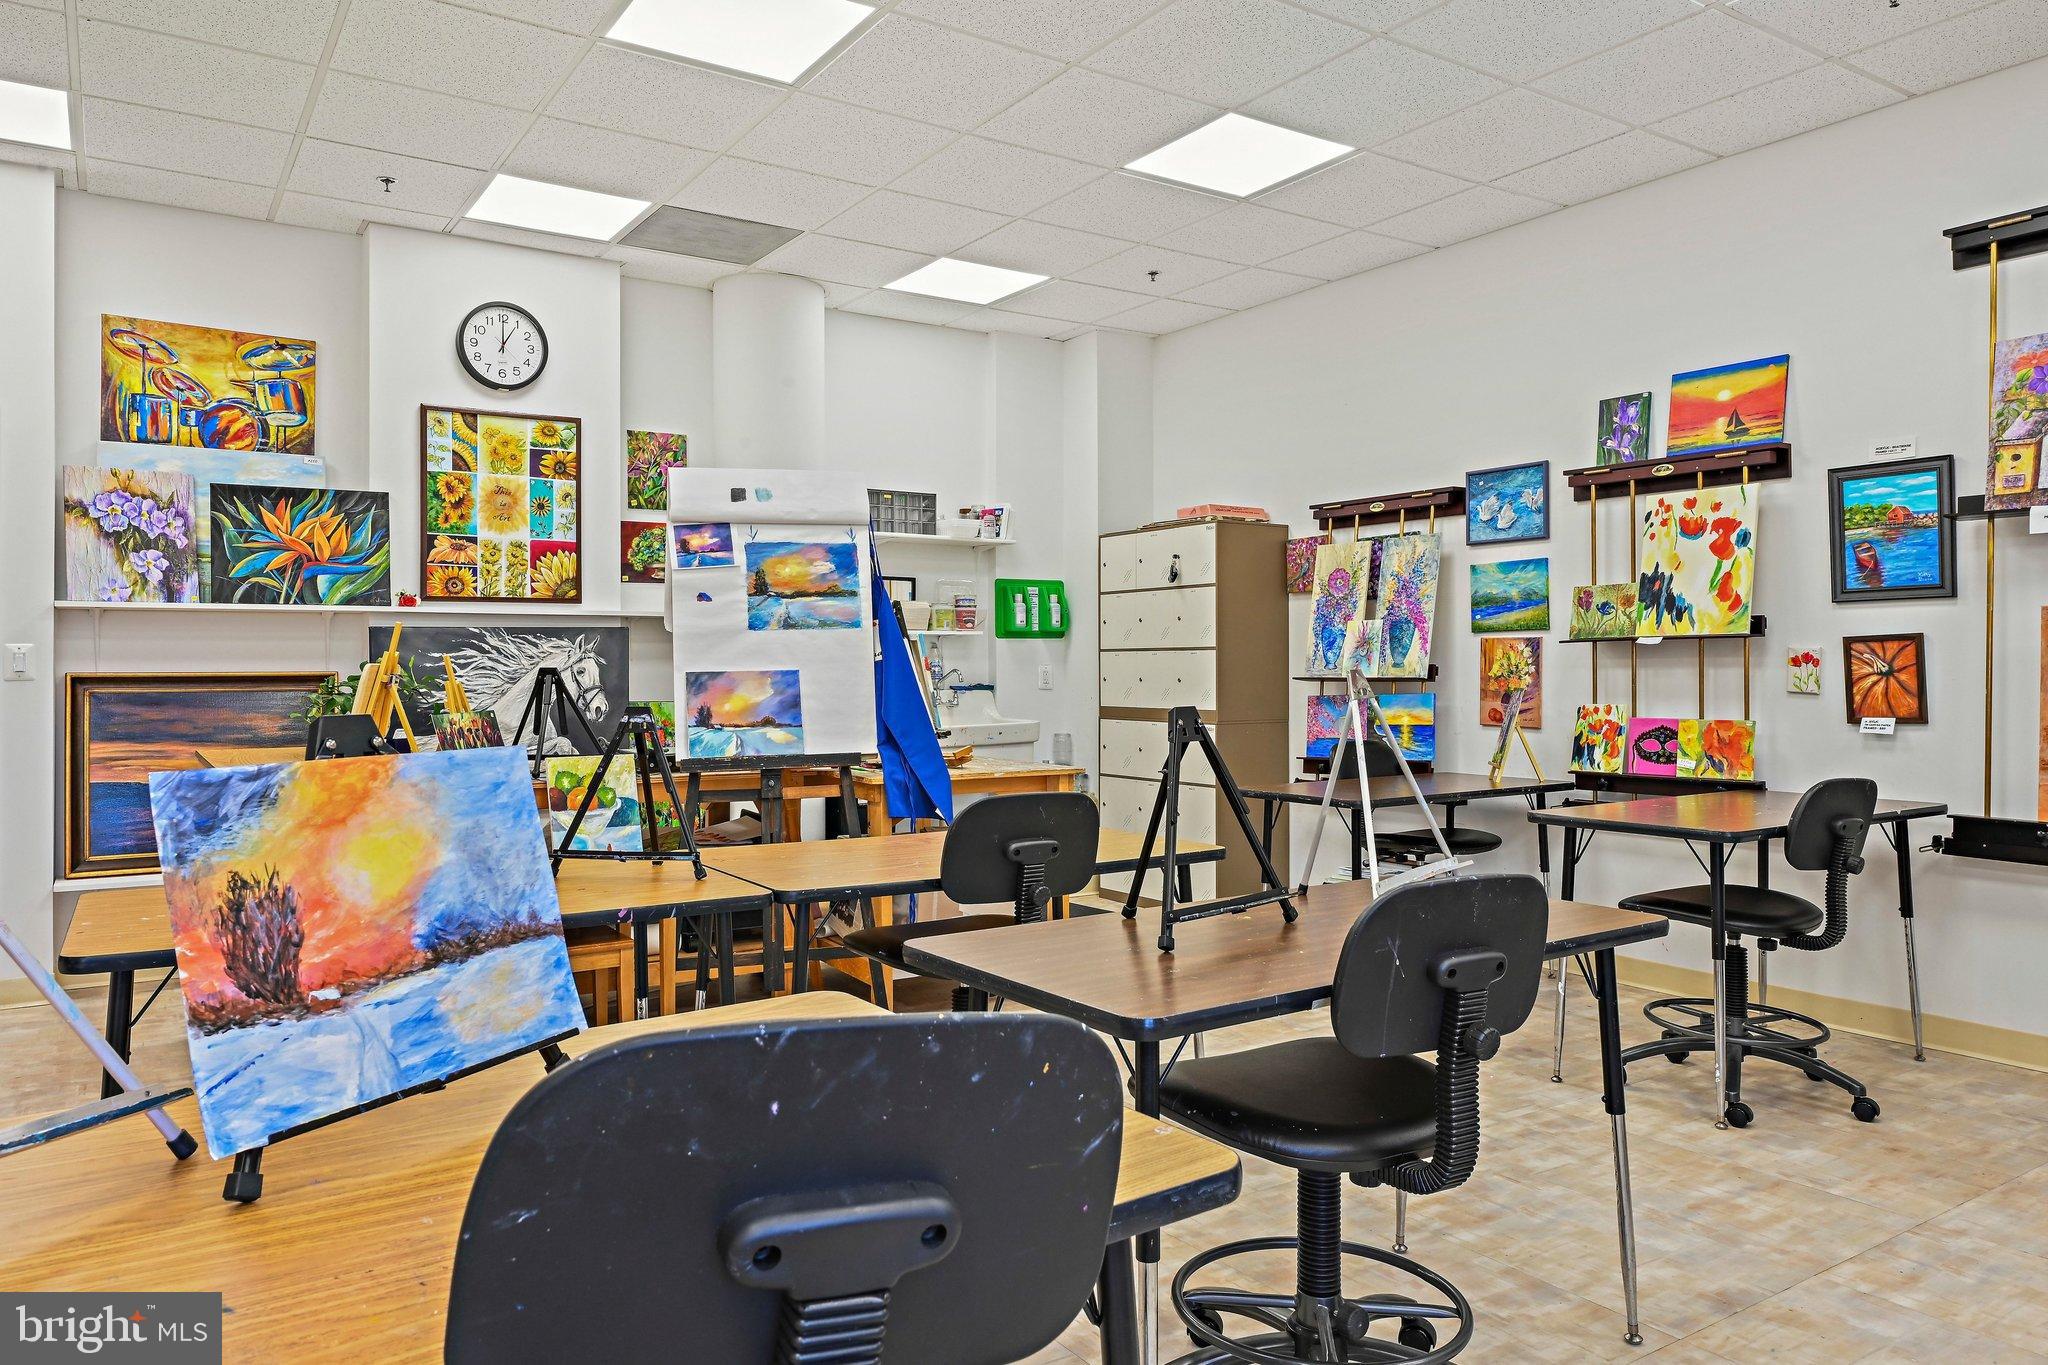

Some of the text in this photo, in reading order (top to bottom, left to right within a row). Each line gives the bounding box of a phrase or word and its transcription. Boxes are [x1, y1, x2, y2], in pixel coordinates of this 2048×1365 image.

[485, 316, 494, 326] 11
[498, 313, 509, 324] 12
[515, 320, 519, 329] 1
[473, 325, 486, 335] 10
[523, 332, 531, 341] 2
[469, 337, 478, 347] 9
[527, 345, 535, 354] 3
[473, 352, 482, 361] 8
[523, 358, 531, 367] 4
[484, 363, 492, 372] 7
[512, 366, 521, 376] 5
[498, 368, 507, 378] 6
[494, 484, 512, 496] This
[492, 512, 511, 521] Art
